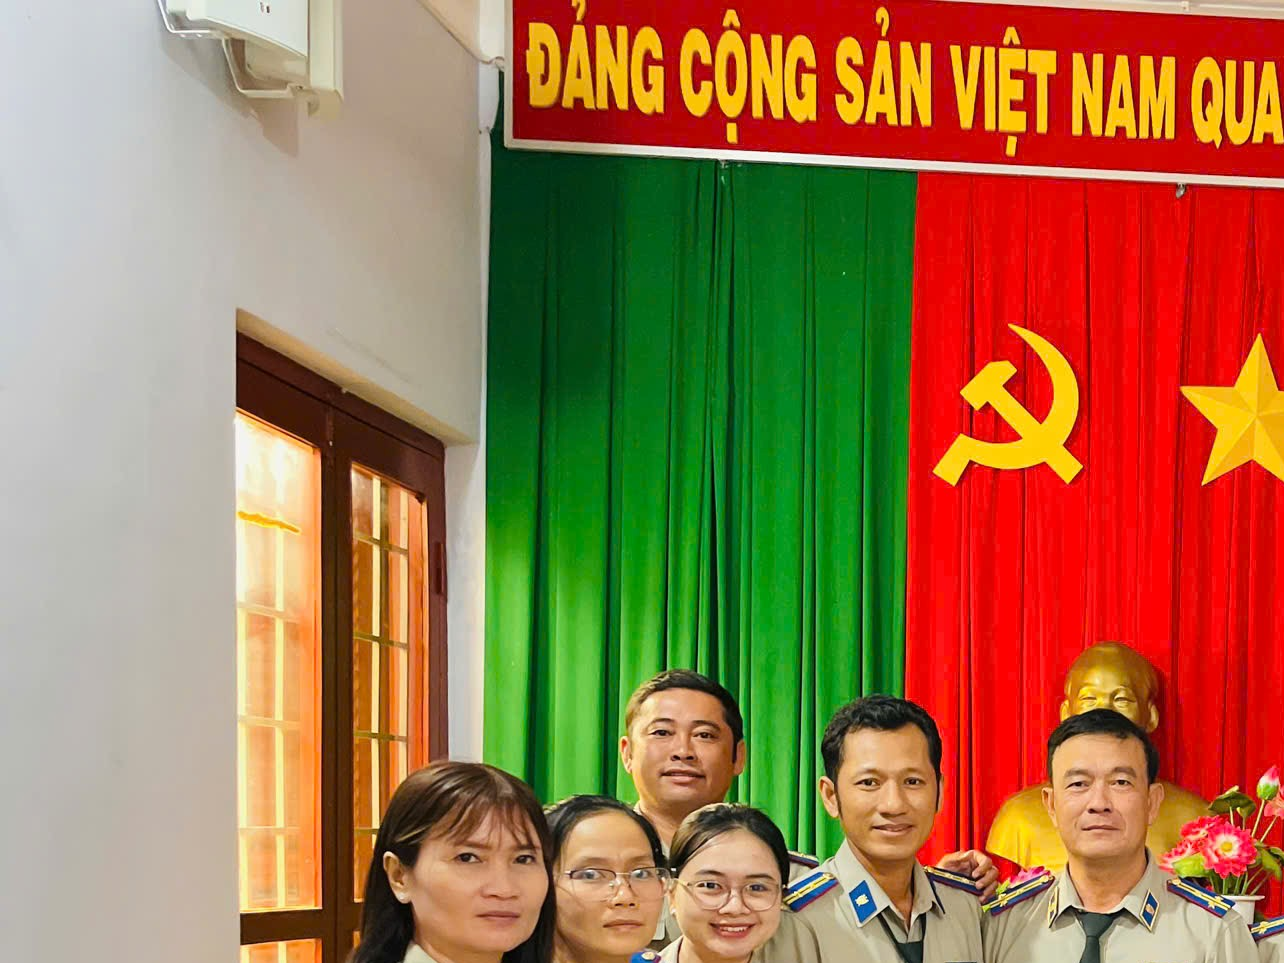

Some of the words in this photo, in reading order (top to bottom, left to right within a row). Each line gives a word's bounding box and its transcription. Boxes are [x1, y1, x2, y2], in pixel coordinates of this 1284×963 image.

[526, 0, 664, 114] ĐẢNG
[680, 10, 816, 143] CỘNG
[835, 7, 931, 126] SẢN
[950, 27, 1056, 156] VIỆT
[1072, 53, 1175, 139] NAM
